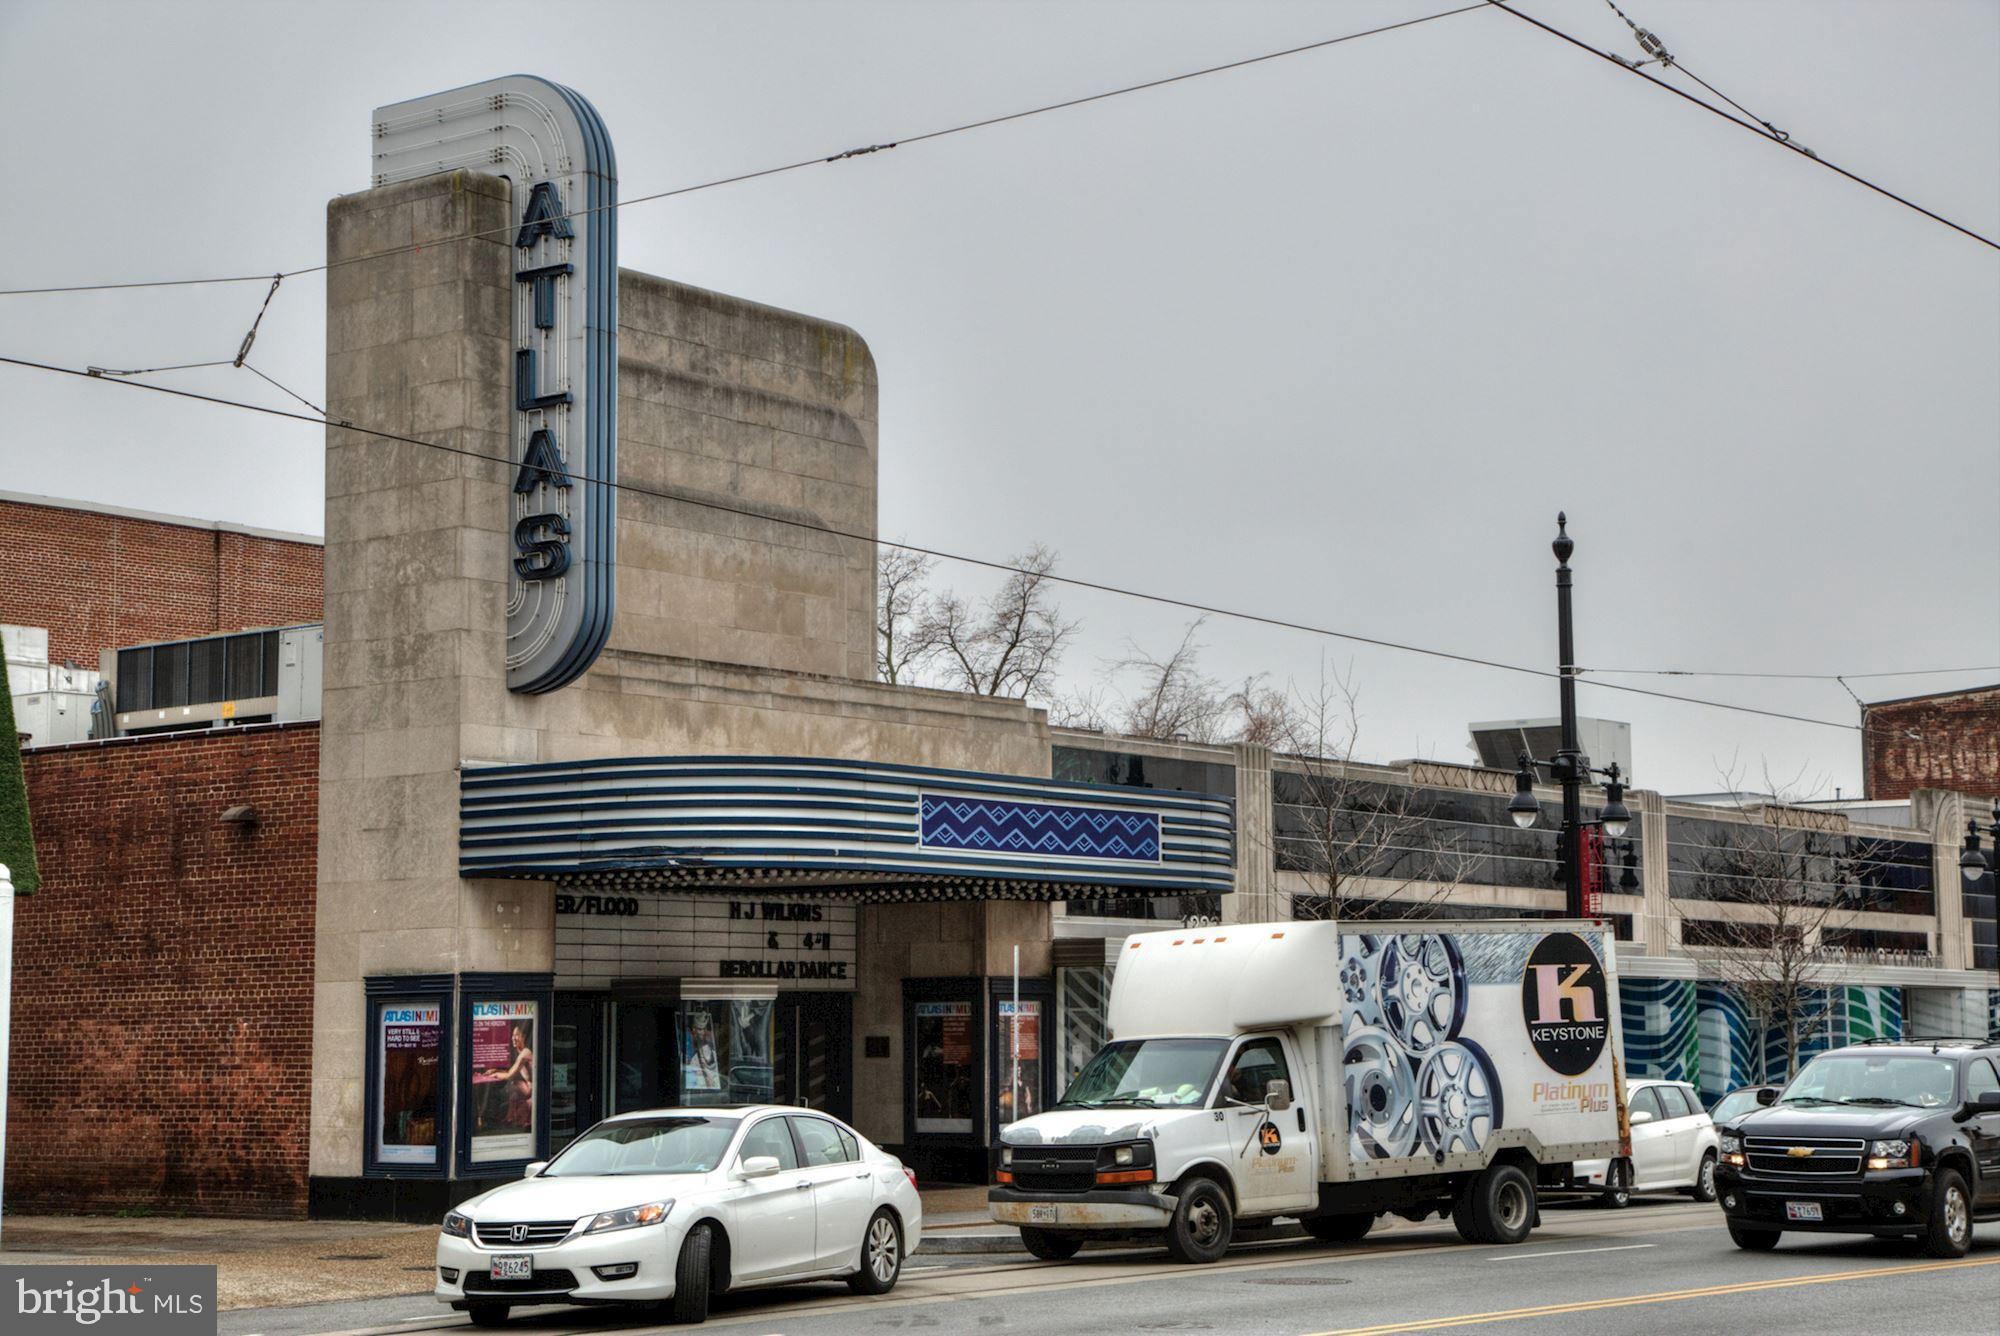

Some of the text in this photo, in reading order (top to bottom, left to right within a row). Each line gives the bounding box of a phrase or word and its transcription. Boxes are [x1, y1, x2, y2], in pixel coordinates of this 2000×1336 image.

[513, 181, 575, 581] ATLAS
[761, 902, 823, 921] WILKINS
[799, 961, 847, 979] DANCE
[1528, 963, 1604, 1024] K
[1532, 1026, 1605, 1042] KEYSTONE
[1532, 1081, 1608, 1102] Platinum
[1580, 1098, 1608, 1113] Plus
[1213, 1112, 1224, 1121] 30
